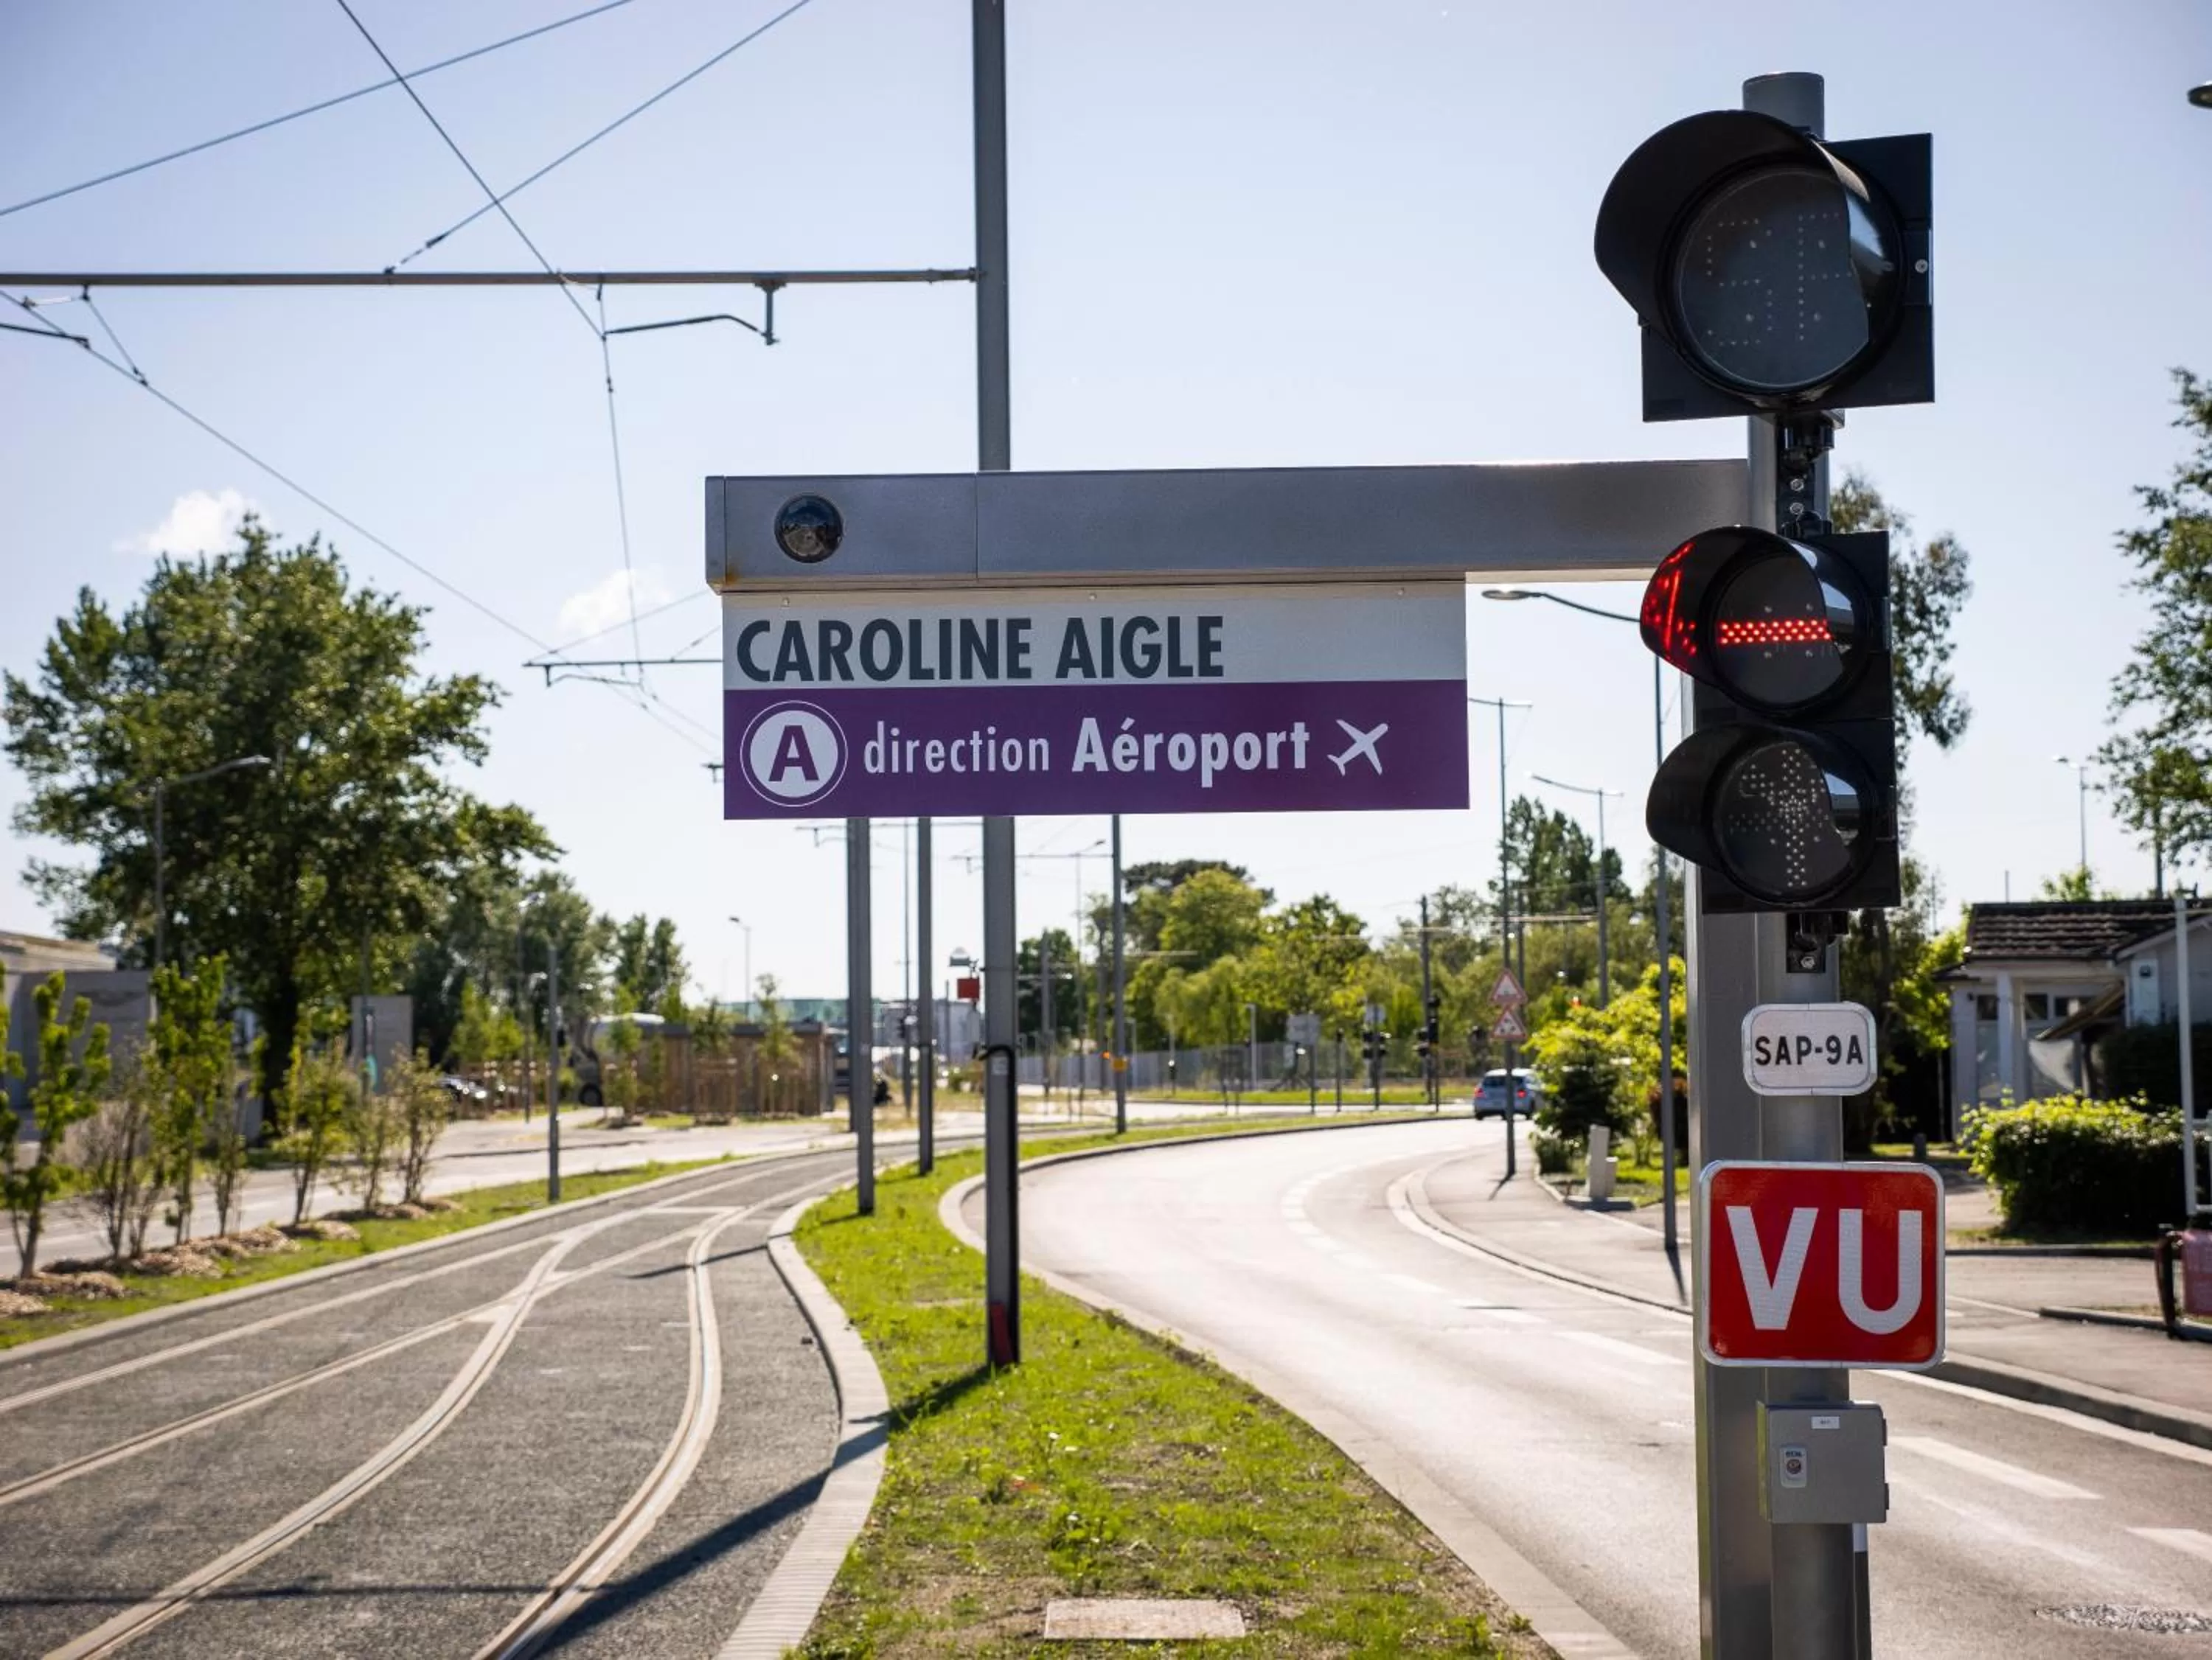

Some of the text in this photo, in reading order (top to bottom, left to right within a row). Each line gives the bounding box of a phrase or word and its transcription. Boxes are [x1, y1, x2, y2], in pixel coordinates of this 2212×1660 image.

[737, 615, 1224, 682] CAROLINE AIGLE
[768, 716, 1311, 788] A direction Aéroport
[1754, 1034, 1864, 1067] SAP-9A
[1725, 1204, 1923, 1335] VU
